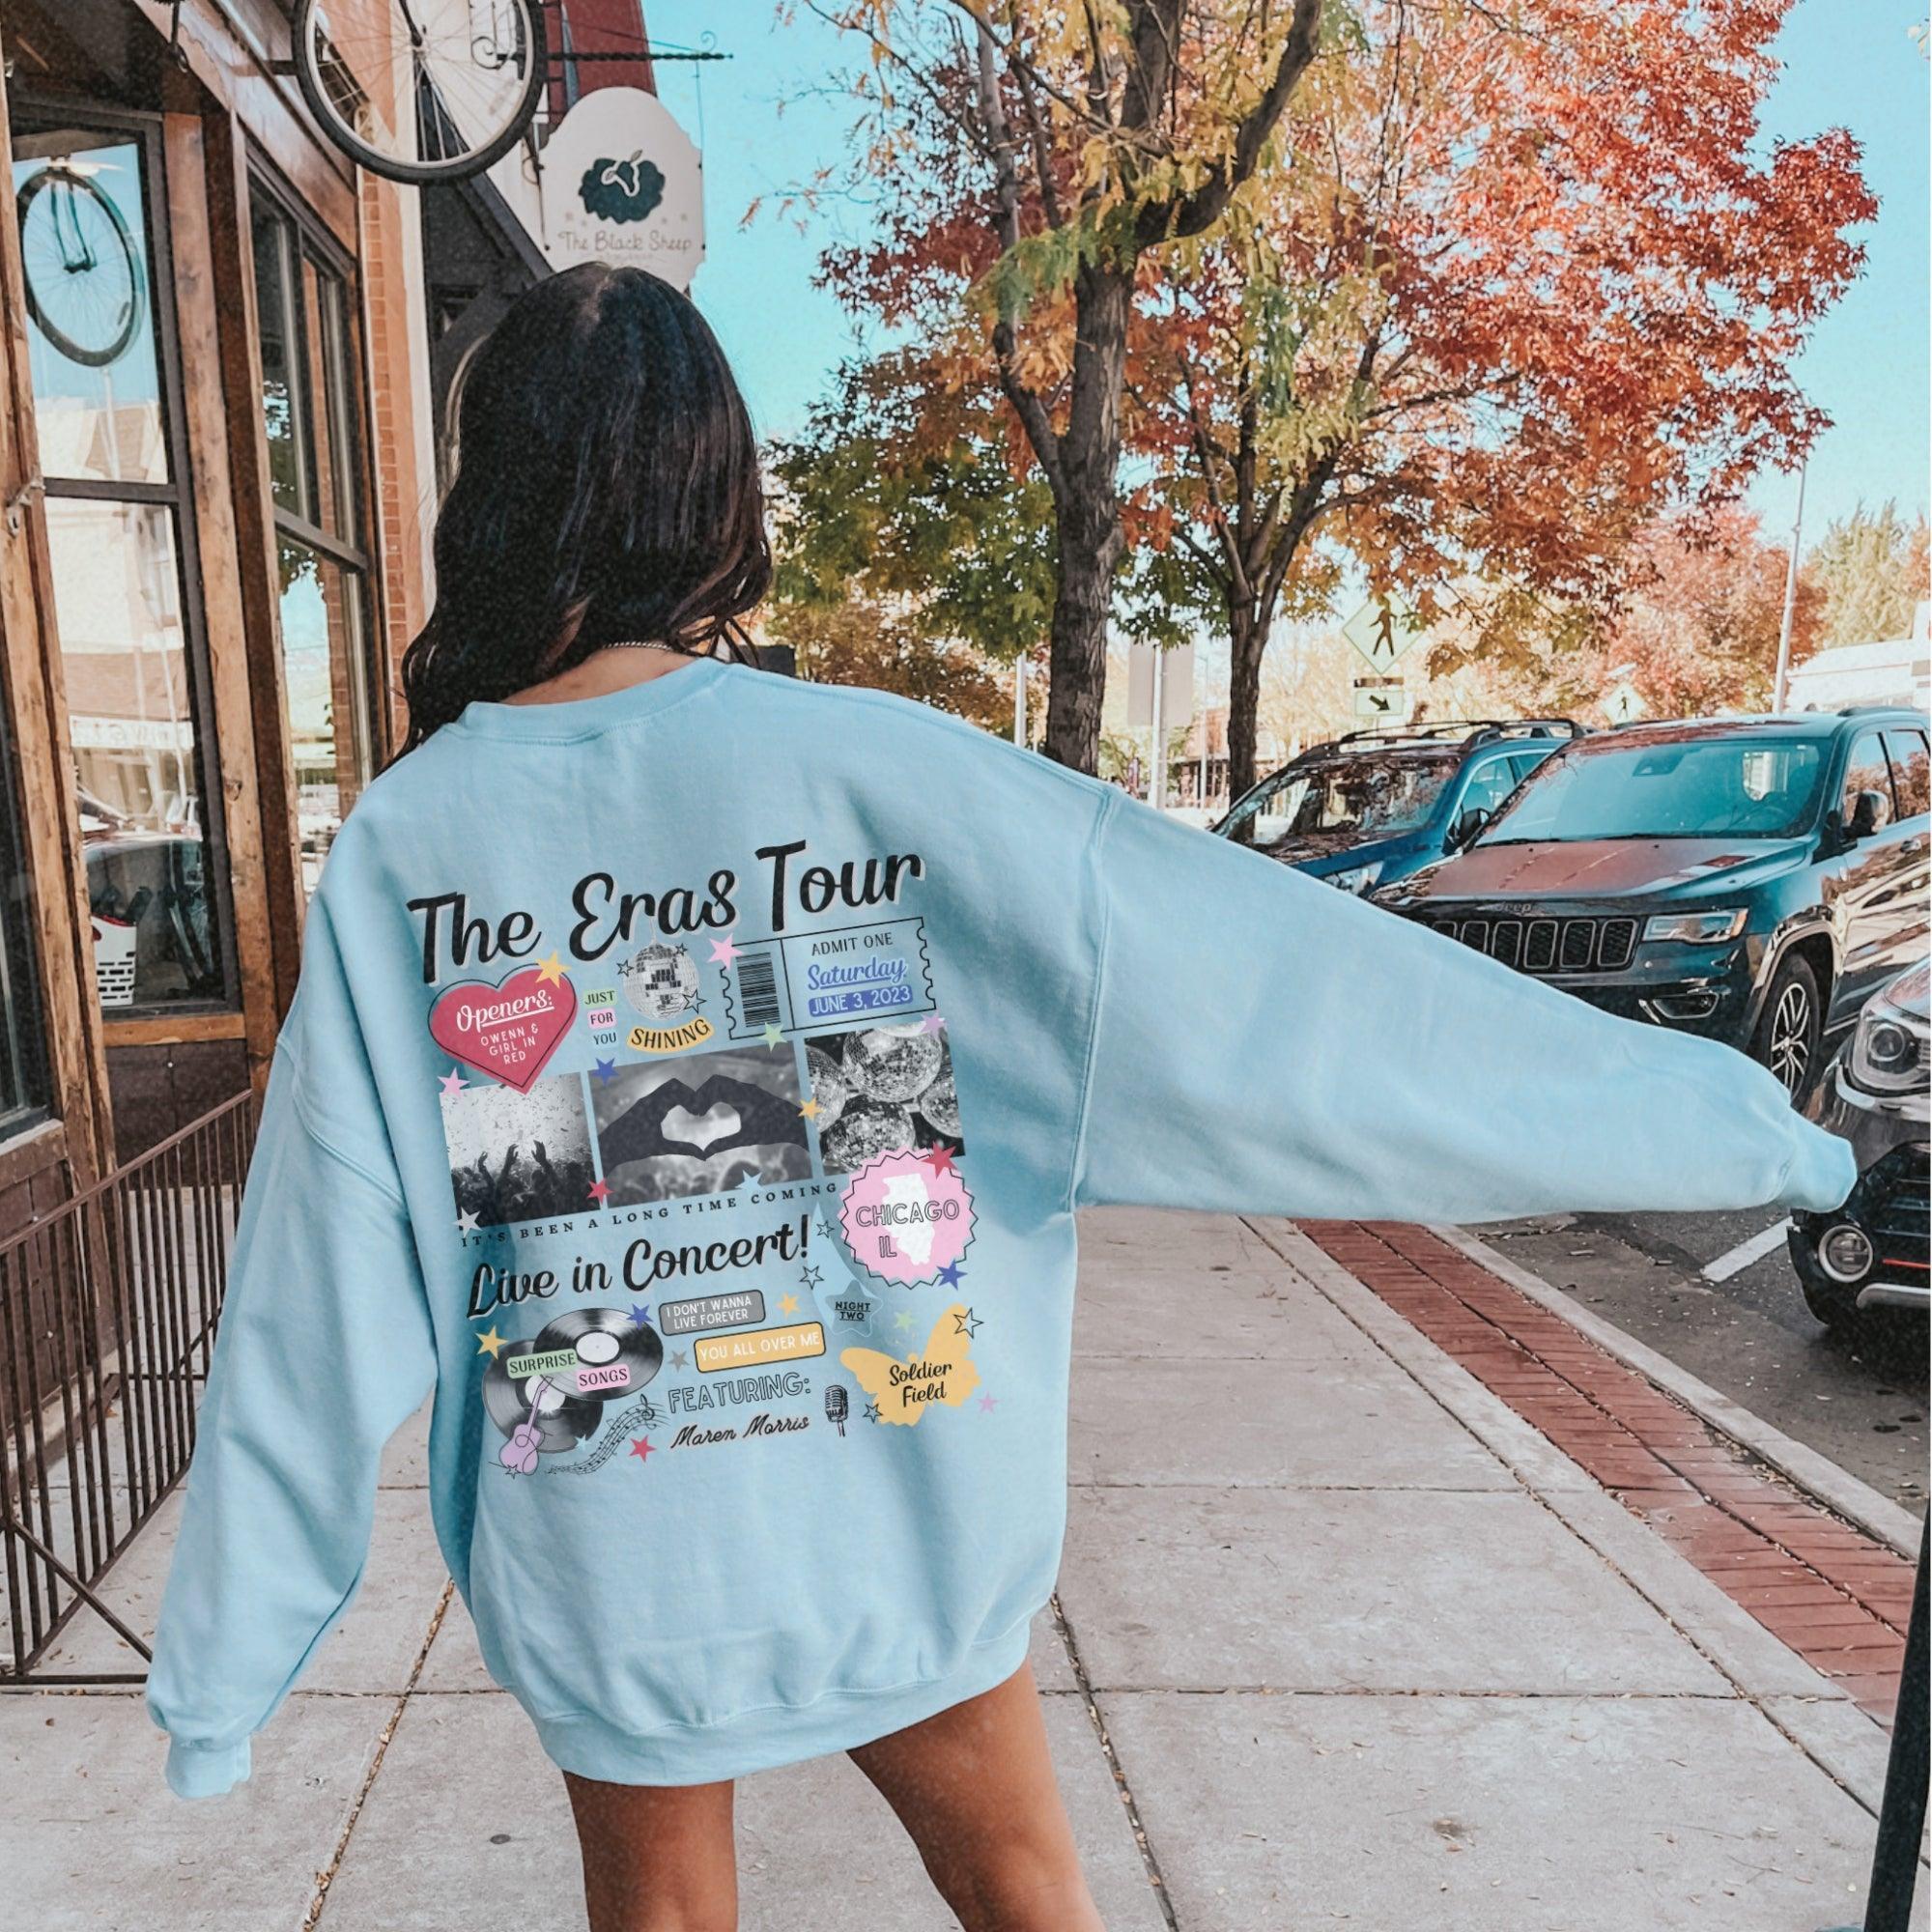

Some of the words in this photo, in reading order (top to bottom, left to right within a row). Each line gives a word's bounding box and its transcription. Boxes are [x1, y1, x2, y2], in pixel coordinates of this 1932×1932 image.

[557, 231, 588, 250] The
[595, 230, 642, 251] Black
[649, 230, 692, 252] Sheep
[406, 891, 542, 984] The
[569, 869, 736, 962] Eras
[754, 839, 922, 931] Tour
[811, 937, 857, 956] ADMIT
[864, 932, 893, 949] ONE
[583, 990, 614, 1005] JUST
[811, 994, 848, 1014] JUNE
[854, 991, 867, 1009] 3,
[872, 985, 911, 1005] 2023
[456, 989, 554, 1034] Openers:
[590, 1012, 613, 1024] FOR
[480, 1027, 526, 1045] OWENN
[531, 1024, 538, 1034] &
[593, 1033, 616, 1044] YOU
[631, 1019, 710, 1048] SHINING
[489, 1041, 518, 1056] GIRL
[524, 1037, 535, 1047] IN
[503, 1051, 526, 1065] RED
[462, 1232, 506, 1247] IT'S
[520, 1222, 574, 1238] BEEN
[588, 1219, 599, 1229] A
[612, 1208, 668, 1225] LONG
[683, 1198, 737, 1214] TIME
[752, 1183, 838, 1205] COMING
[856, 1199, 959, 1228] CHICAGO
[879, 1236, 897, 1258] IL
[468, 1263, 558, 1318] Live
[572, 1257, 612, 1293] in
[623, 1214, 809, 1292] Concert!
[673, 1302, 706, 1317] DON'T
[711, 1295, 753, 1311] WANNA
[835, 1300, 870, 1312] NIGHT
[839, 1311, 865, 1321] TWO
[673, 1315, 697, 1329] LIVE
[700, 1310, 749, 1326] FOREVER
[700, 1346, 728, 1362] YOU
[733, 1342, 756, 1358] ALL
[760, 1337, 796, 1353] OVER
[800, 1331, 820, 1348] ME
[509, 1352, 577, 1374] SURPRISE
[889, 1361, 952, 1387] Soldier
[579, 1368, 628, 1387] SONGS
[668, 1372, 812, 1413] FEATURING:
[901, 1382, 948, 1407] Field
[670, 1424, 736, 1449] Maren
[742, 1414, 810, 1439] Morris
